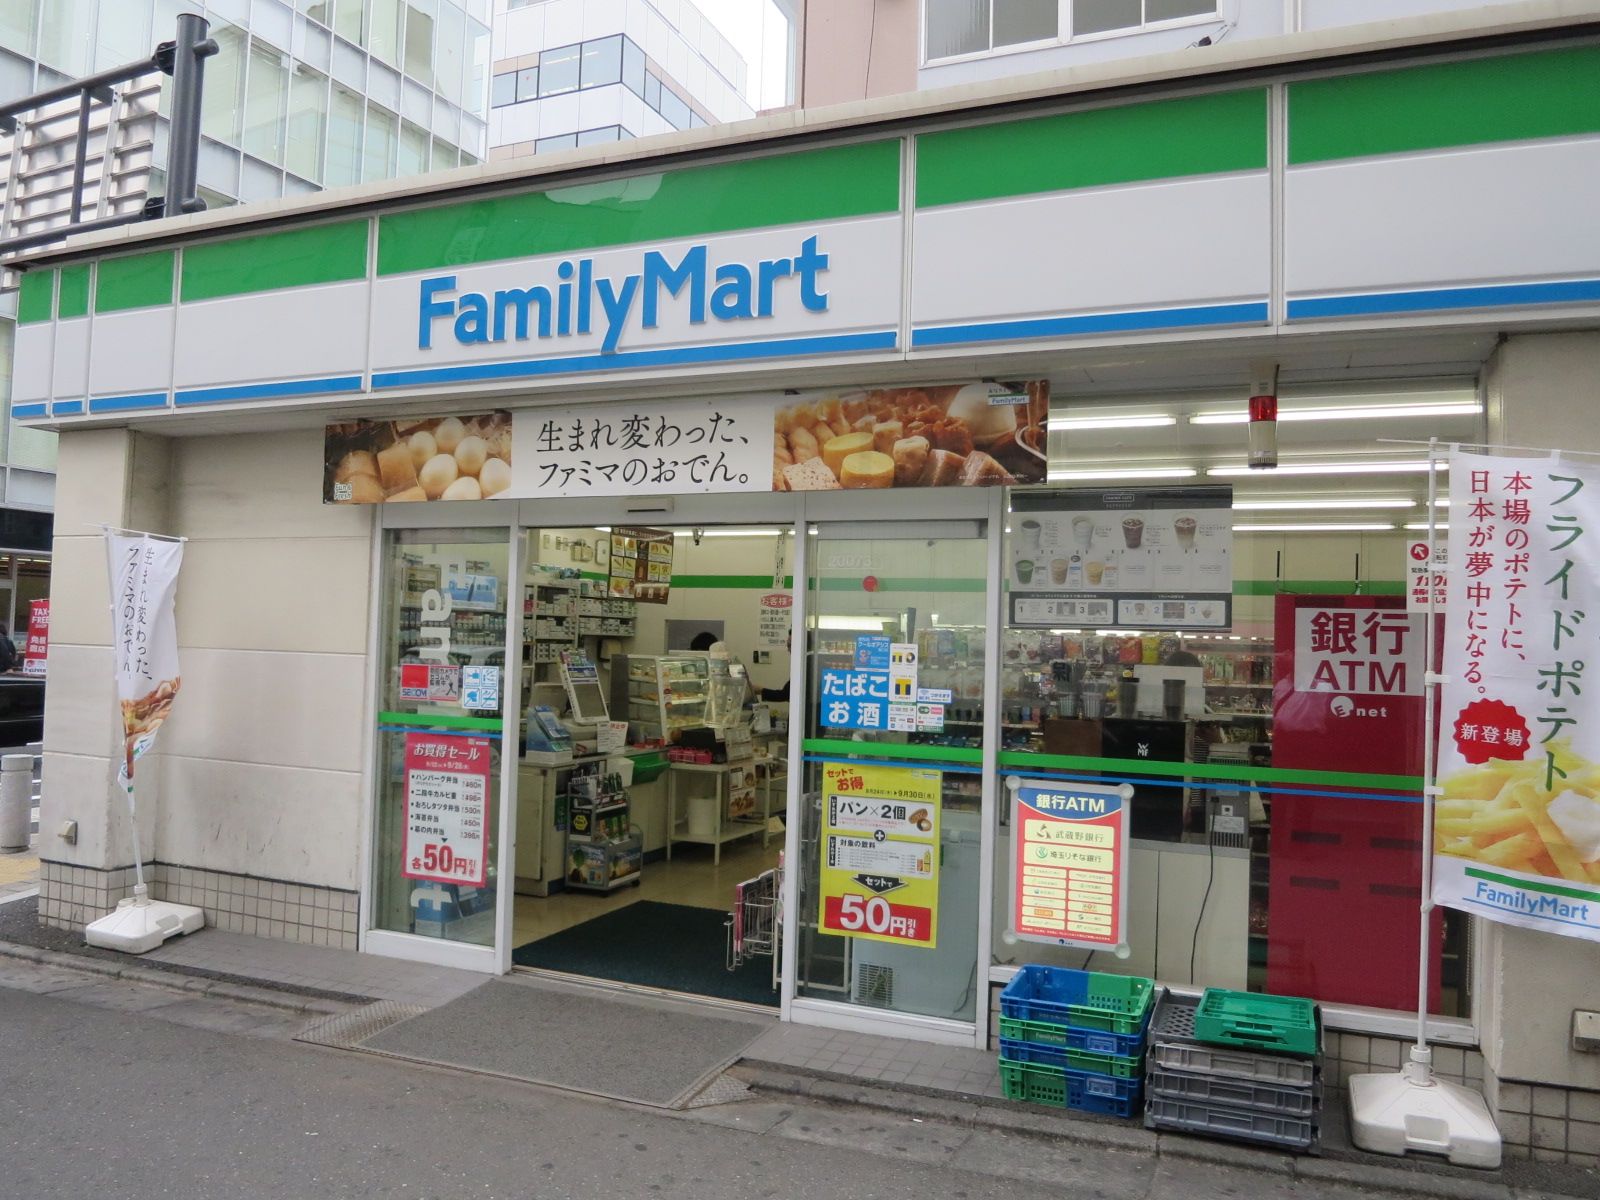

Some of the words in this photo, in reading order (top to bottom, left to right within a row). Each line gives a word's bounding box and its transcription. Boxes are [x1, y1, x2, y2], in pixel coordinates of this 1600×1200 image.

[418, 234, 829, 354] FamilyMart
[536, 412, 749, 453] 生まれ変わった、
[537, 452, 749, 489] ファミマのおでん。
[1502, 471, 1532, 660] 本場のポテトに、
[1464, 470, 1495, 694] 日本が夢中になる。
[1310, 611, 1410, 656] 銀行
[1537, 474, 1585, 791] フライドポテト
[824, 672, 887, 697] たばこ
[1309, 660, 1406, 693] ATM
[402, 688, 428, 697] SECOM
[828, 701, 880, 726] お酒
[1356, 707, 1387, 717] net
[1460, 722, 1523, 746] 新登場
[414, 743, 480, 761] お買得セール
[415, 774, 458, 784] ハンバーグ弁当
[826, 769, 854, 778] セットで
[837, 776, 864, 791] お得
[415, 801, 460, 812] おろしタツタ弁当
[839, 802, 906, 820] パン×2個
[1036, 793, 1105, 813] 銀行ATM
[414, 825, 445, 836] 幕の内弁当
[1055, 830, 1104, 842] 武蔵野銀行
[840, 839, 875, 849] 対象の飲料
[1050, 851, 1102, 863] 埼玉りそな銀行
[865, 877, 893, 888] セットで
[1476, 882, 1588, 920] FamilyMart
